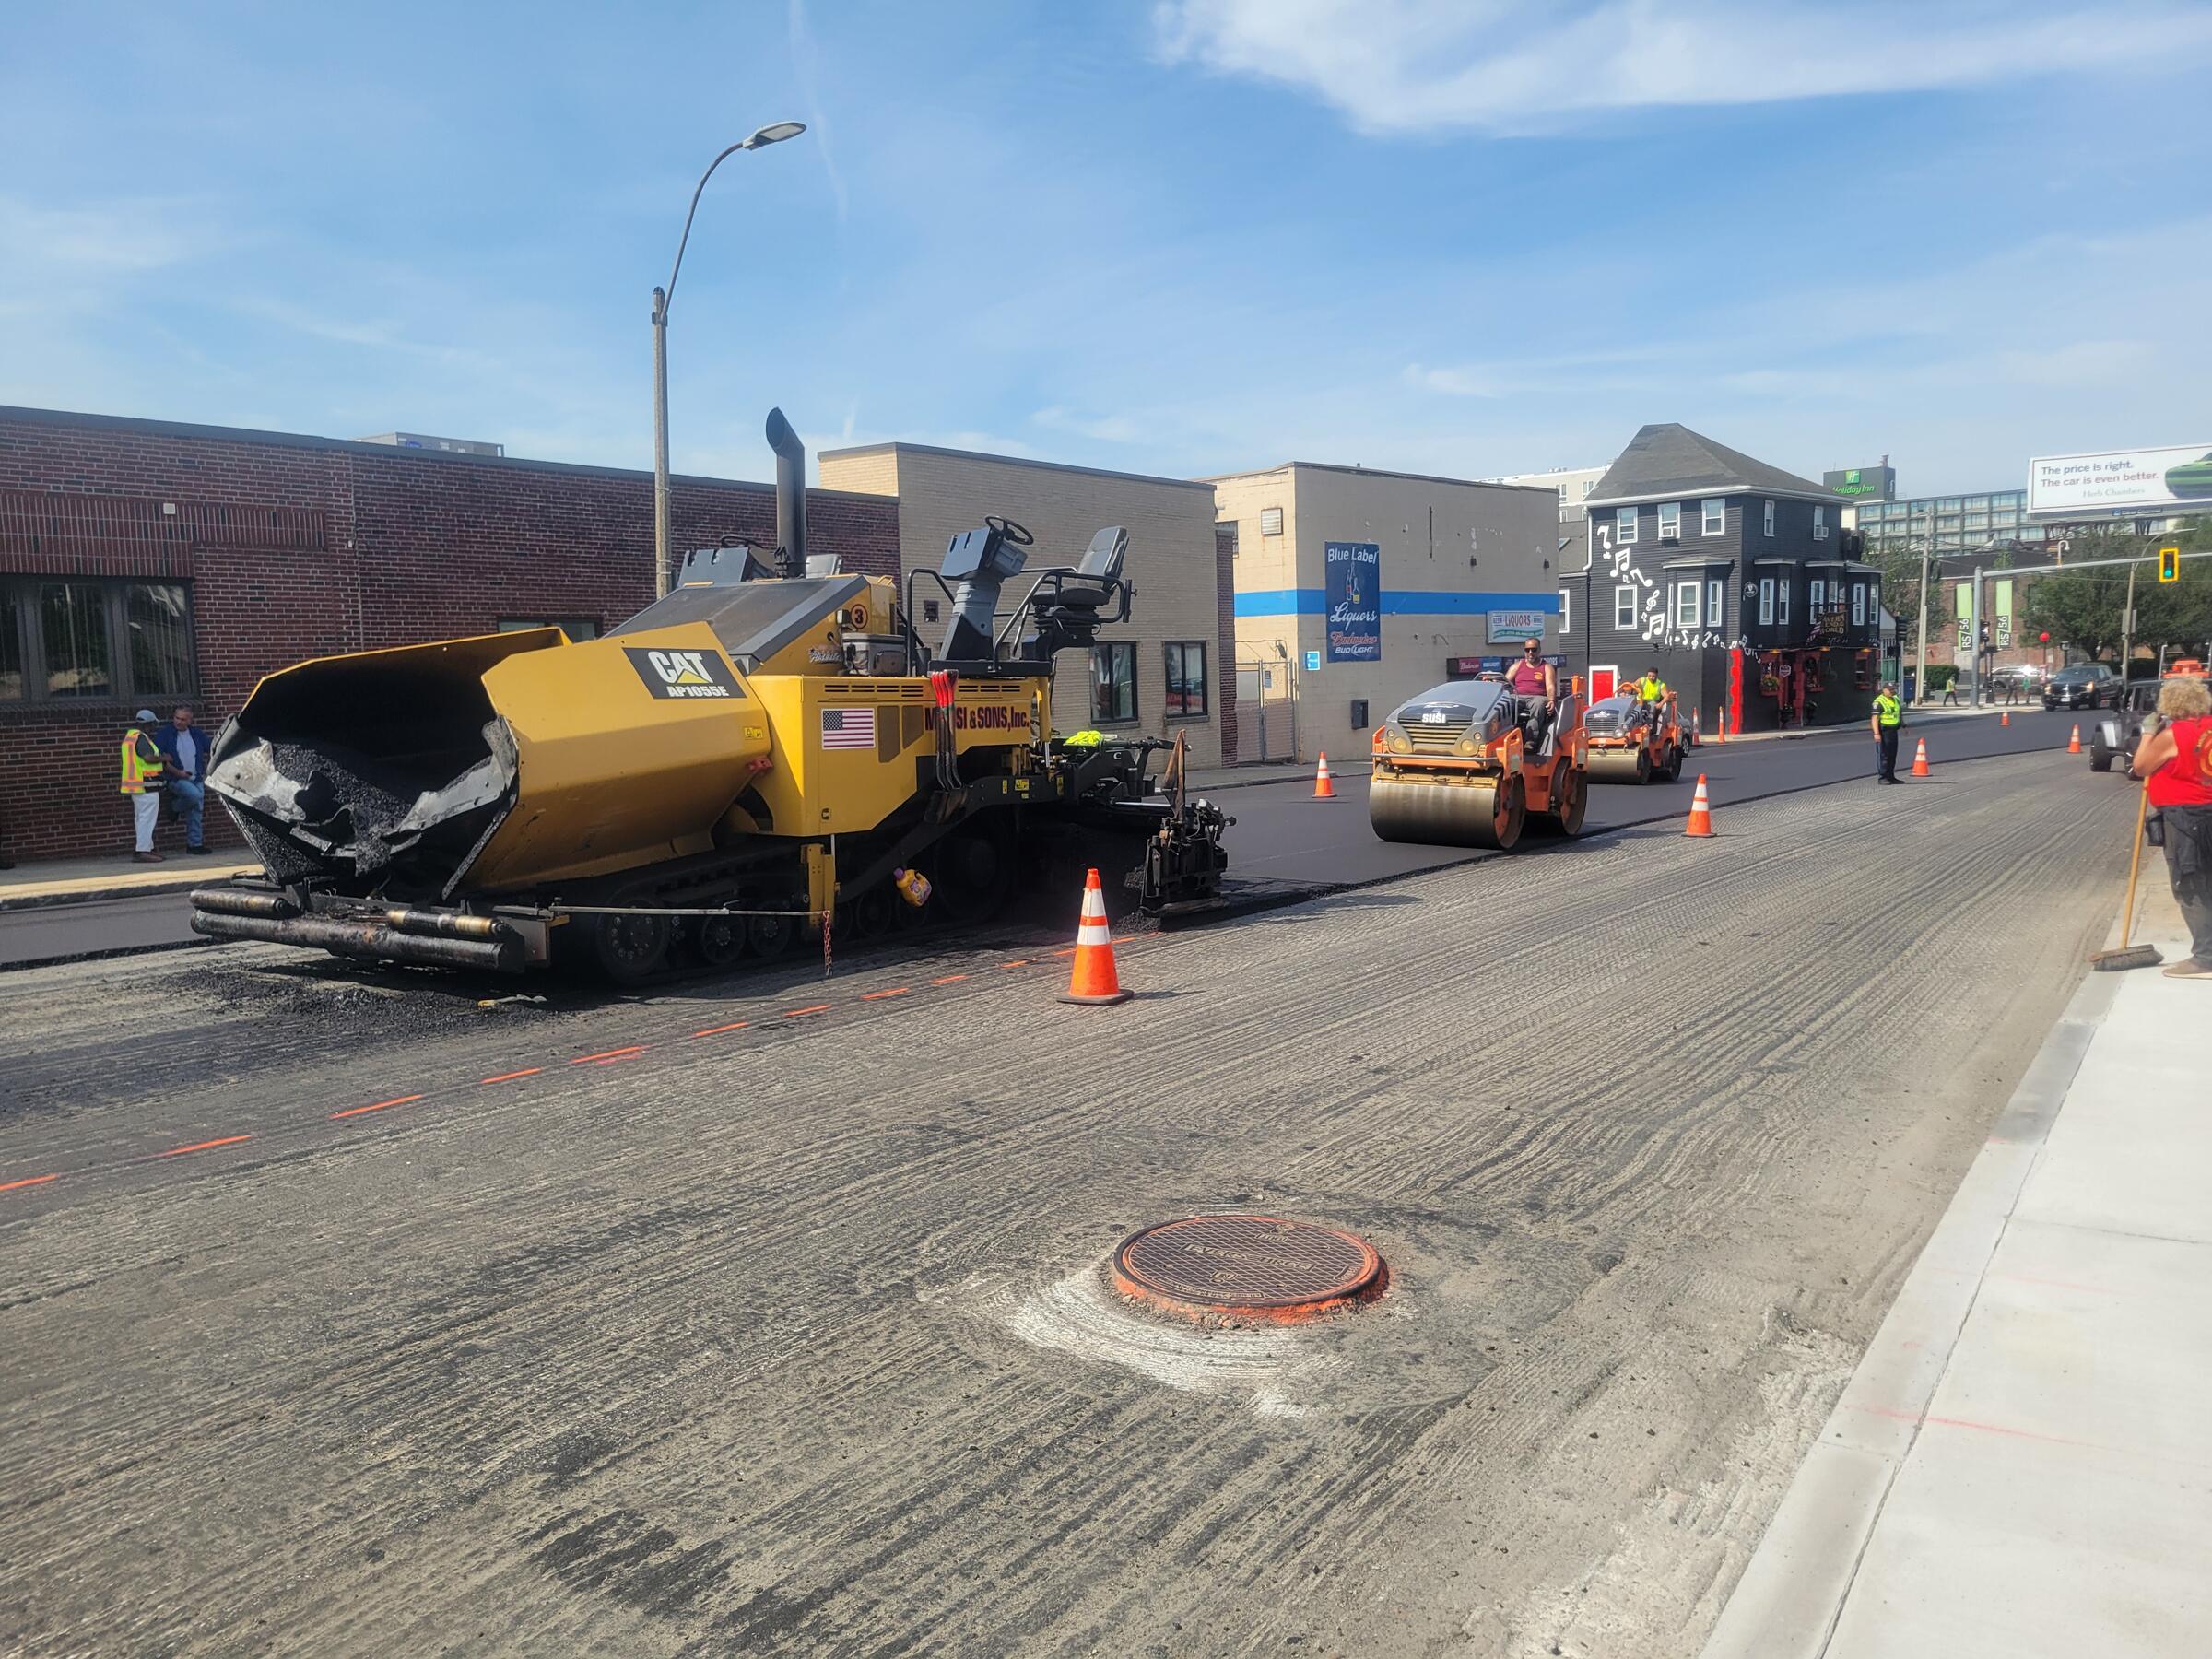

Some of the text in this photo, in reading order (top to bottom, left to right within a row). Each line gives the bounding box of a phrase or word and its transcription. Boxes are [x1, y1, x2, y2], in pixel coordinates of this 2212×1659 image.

[2041, 460, 2134, 475] The price is right.
[2041, 478, 2061, 487] The
[2083, 476, 2092, 485] is
[2123, 471, 2159, 481] better.
[1832, 484, 1875, 495] Holiday Inn
[1327, 546, 1379, 564] Blue Label
[854, 609, 864, 624] 3
[1330, 601, 1378, 631] Liquors
[1959, 618, 1972, 648] RS/56
[1998, 616, 2011, 646] RS/56
[648, 651, 713, 683] CAT
[666, 686, 729, 697] AP1055E
[970, 710, 977, 729] &
[1183, 1243, 1313, 1271] EVERSURCE
